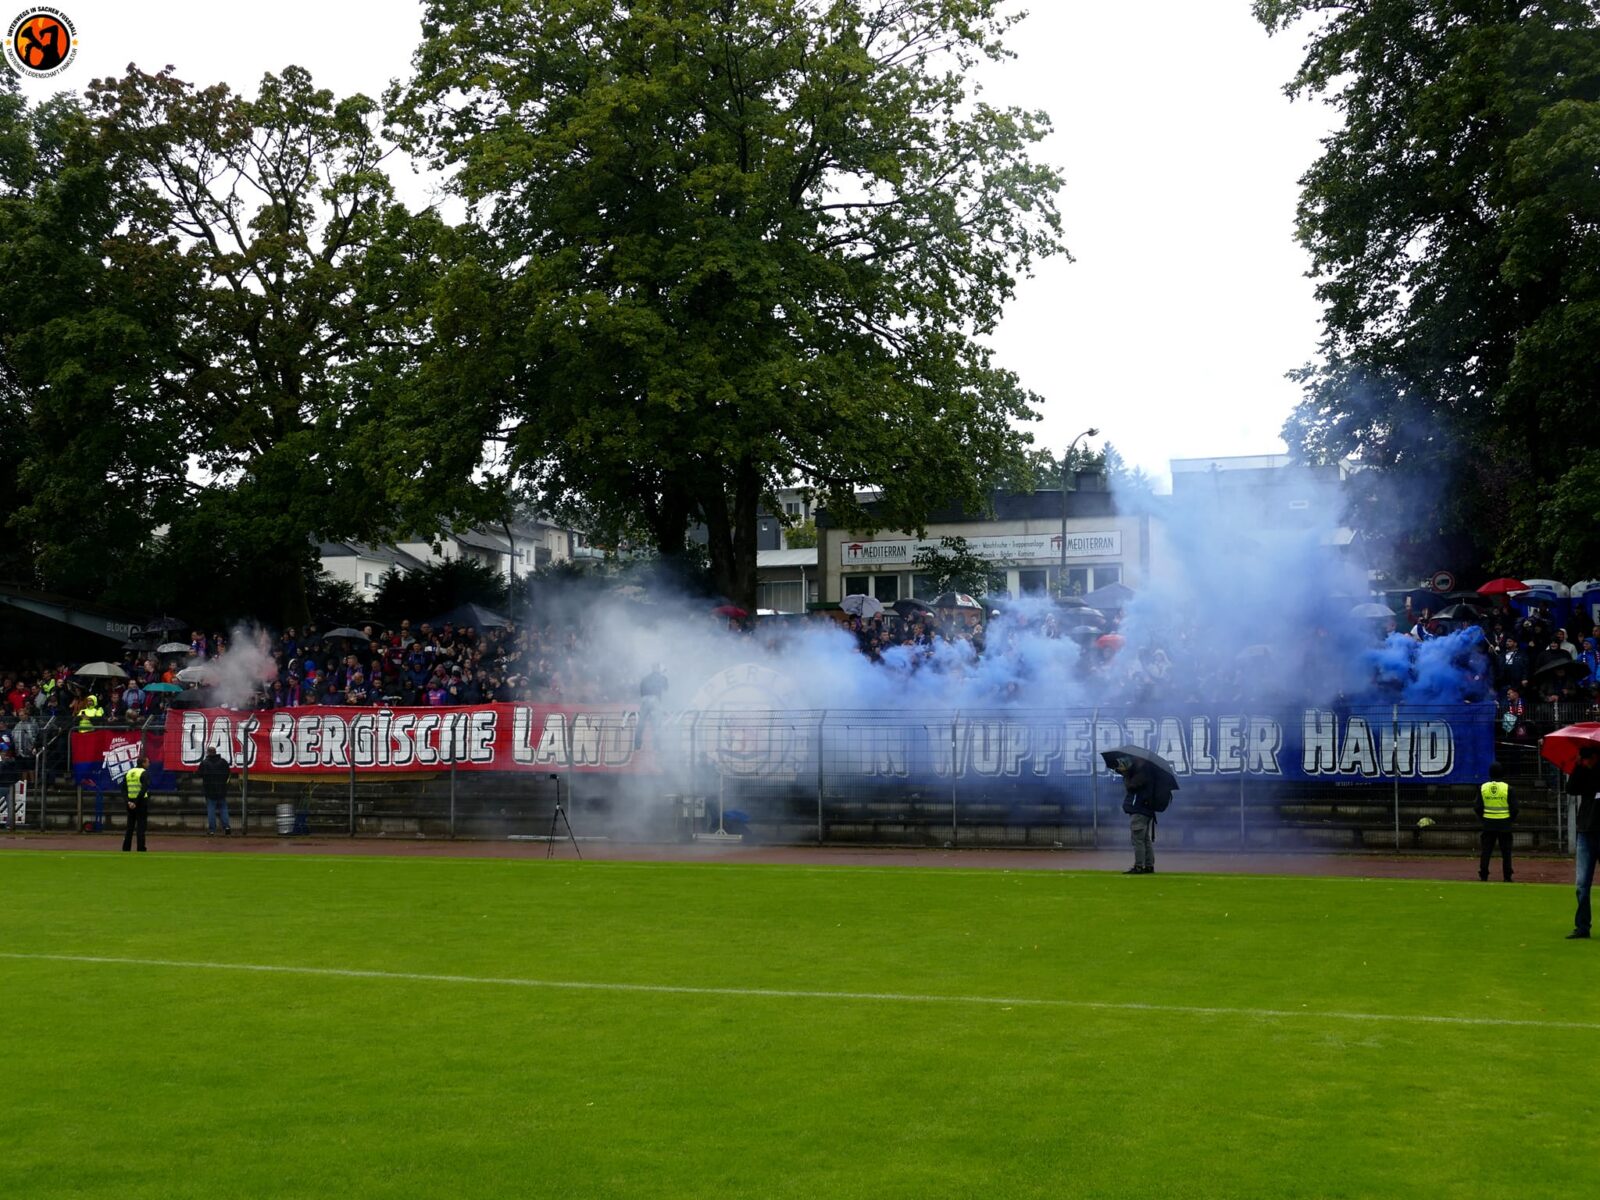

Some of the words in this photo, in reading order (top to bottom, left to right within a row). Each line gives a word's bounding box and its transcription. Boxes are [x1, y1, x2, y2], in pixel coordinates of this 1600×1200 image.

[1067, 536, 1114, 551] MEDITERRAN
[861, 544, 907, 559] MEDITERRAN
[106, 622, 129, 633] BLOCK
[180, 709, 259, 768] DAS
[513, 704, 641, 769] LAND
[925, 714, 1284, 778] WUPPERTALER
[1301, 707, 1456, 779] HAND
